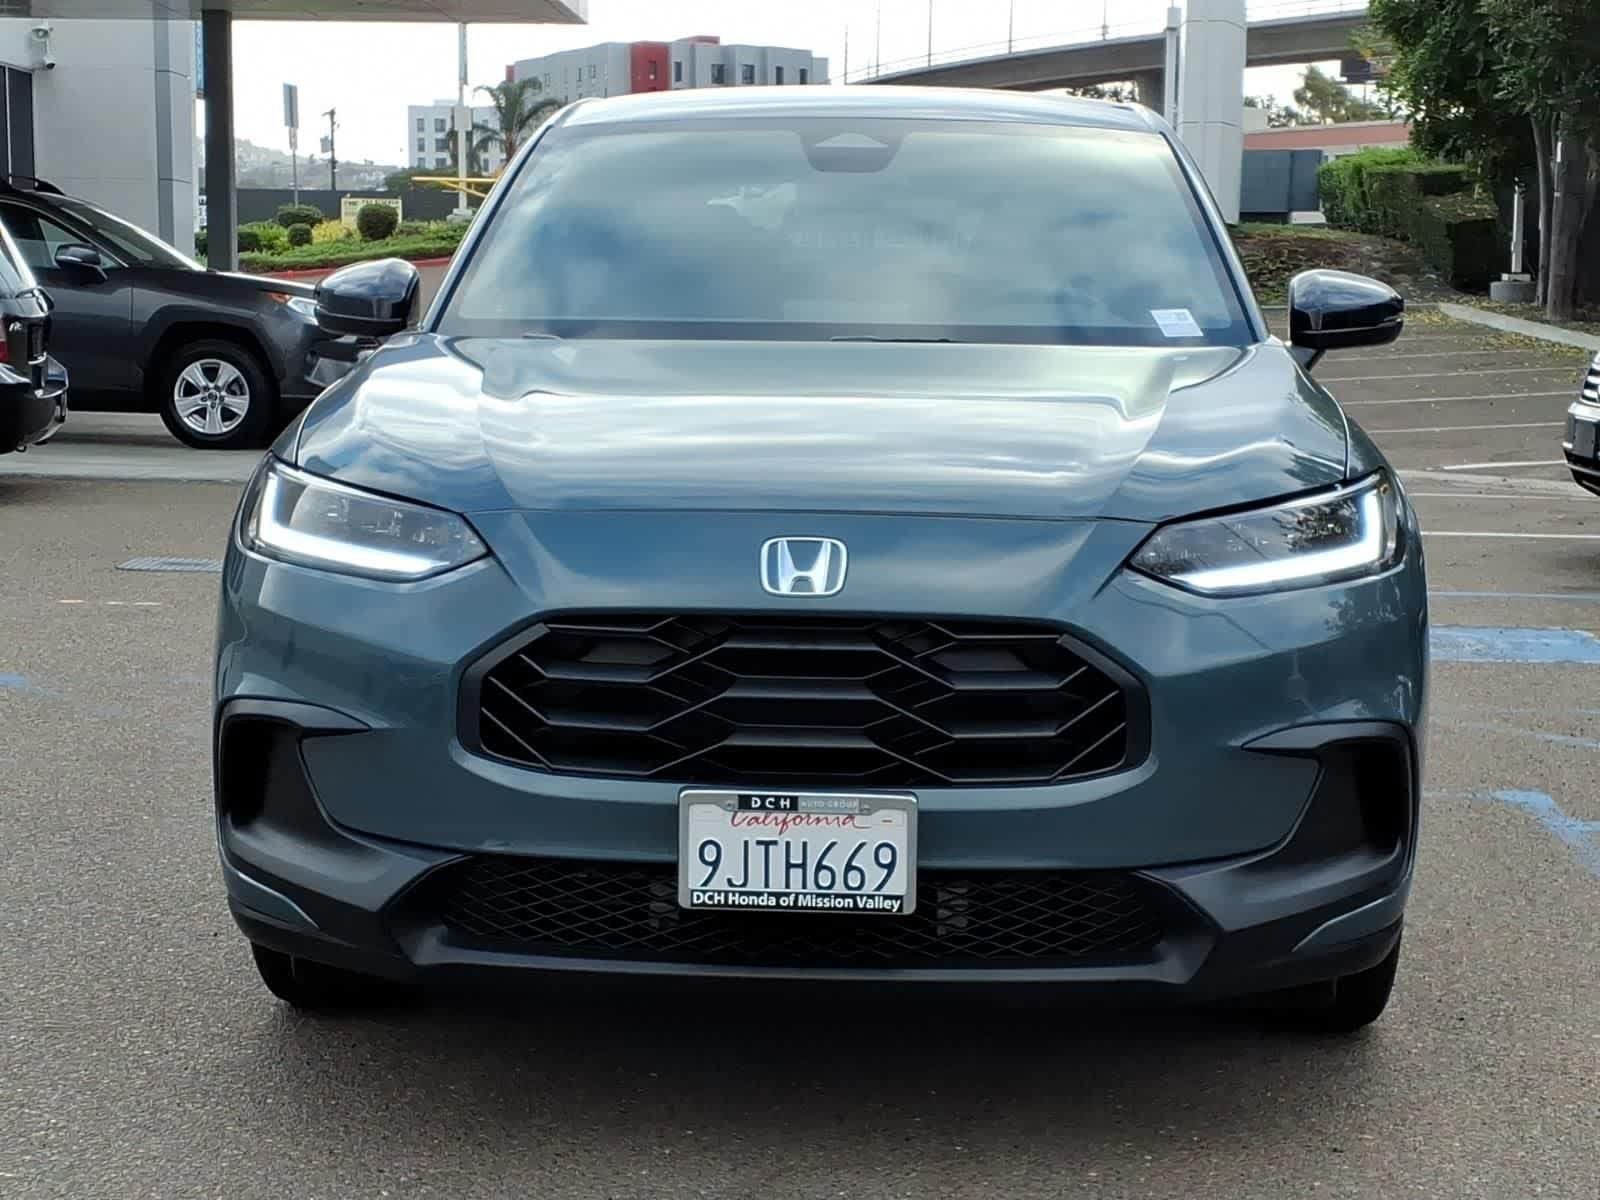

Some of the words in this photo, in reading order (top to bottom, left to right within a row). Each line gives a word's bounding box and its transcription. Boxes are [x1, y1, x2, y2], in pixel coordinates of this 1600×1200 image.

[751, 796, 791, 809] DCH
[731, 811, 871, 835] California
[698, 839, 898, 892] 9JTH669
[692, 892, 725, 905] DCH
[728, 893, 776, 907] Honda
[779, 894, 795, 908] of
[798, 895, 853, 909] Mission
[856, 896, 901, 912] Valley
